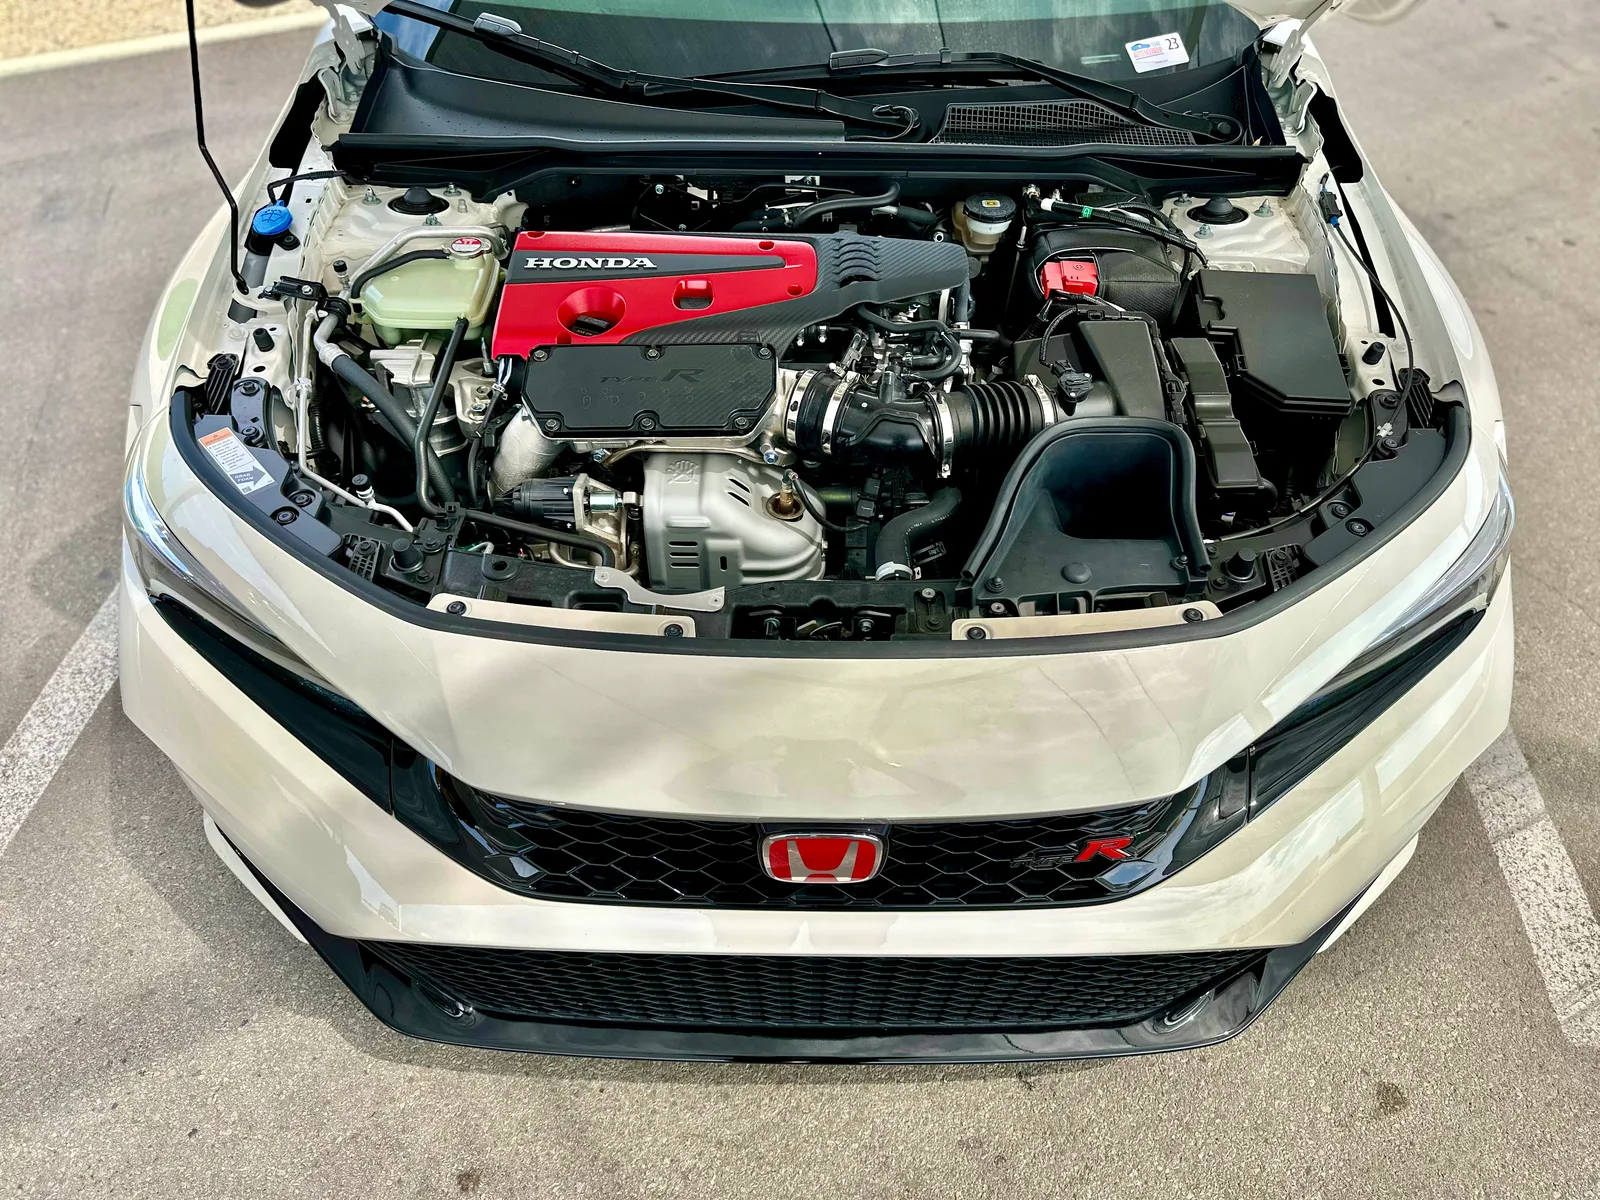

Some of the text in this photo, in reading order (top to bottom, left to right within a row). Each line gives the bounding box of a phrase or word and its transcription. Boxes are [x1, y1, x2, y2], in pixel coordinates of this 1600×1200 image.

[1164, 37, 1180, 51] 23
[523, 257, 657, 270] HONDA
[660, 368, 705, 383] R
[1074, 836, 1134, 863] R
